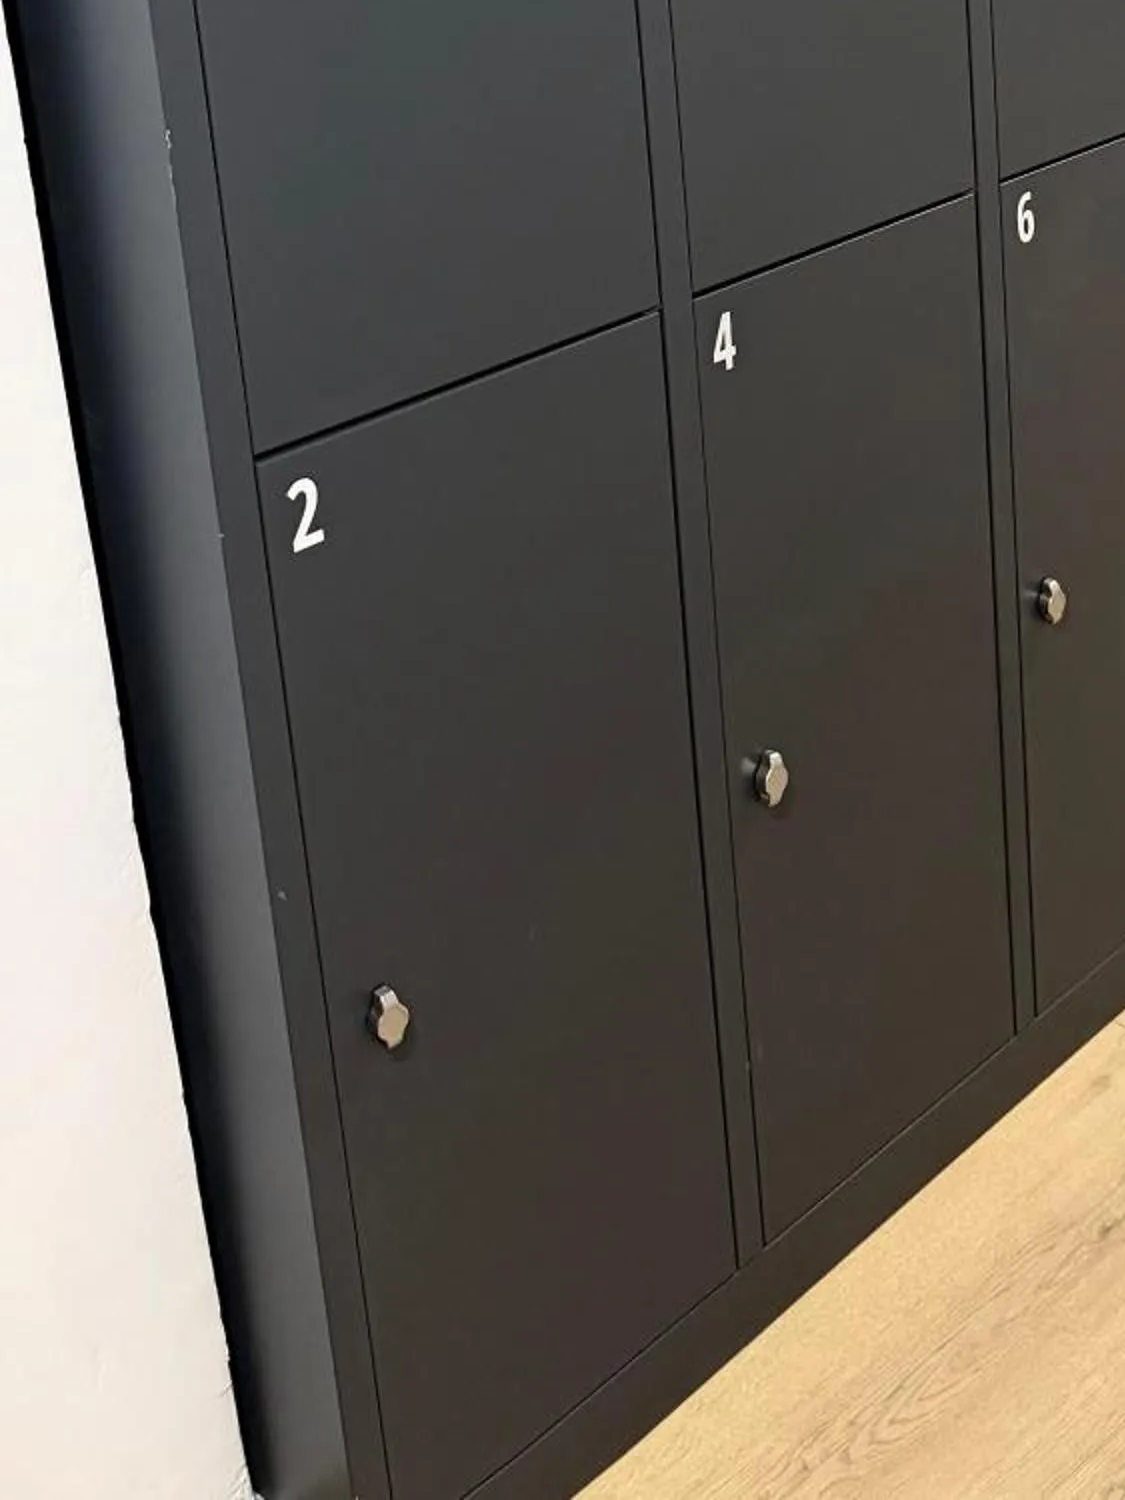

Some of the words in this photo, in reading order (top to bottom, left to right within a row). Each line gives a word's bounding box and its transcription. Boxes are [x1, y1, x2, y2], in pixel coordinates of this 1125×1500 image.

[1017, 190, 1035, 243] 6
[712, 311, 737, 372] 4
[286, 477, 326, 553] 2
